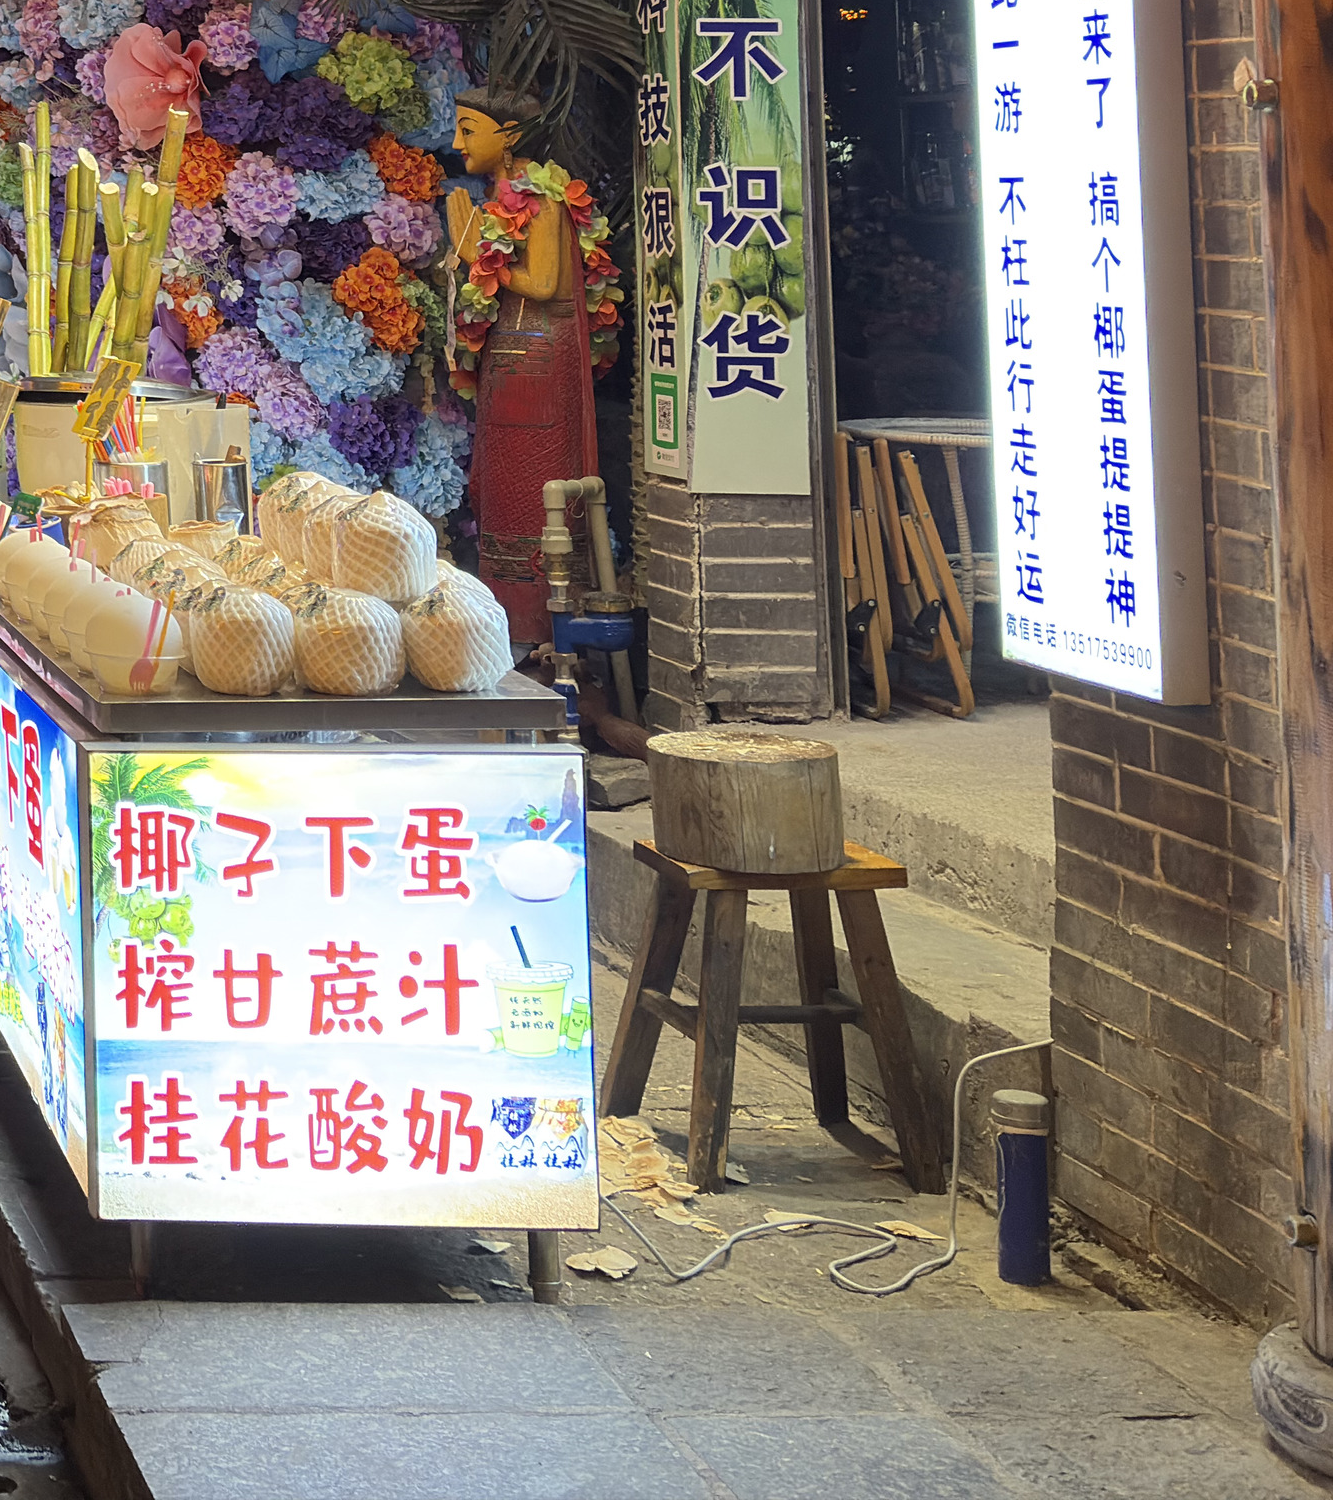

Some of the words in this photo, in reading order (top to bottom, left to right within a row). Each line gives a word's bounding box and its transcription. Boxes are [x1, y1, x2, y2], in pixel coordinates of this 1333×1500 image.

[998, 175, 1045, 605] 不枉此行走好运
[1088, 171, 1137, 630] 搞个椰蛋提提神
[112, 806, 474, 901] 椰子下蛋
[115, 939, 480, 1036] 榨甘蔗汁
[118, 1077, 485, 1176] 桂花酸奶
